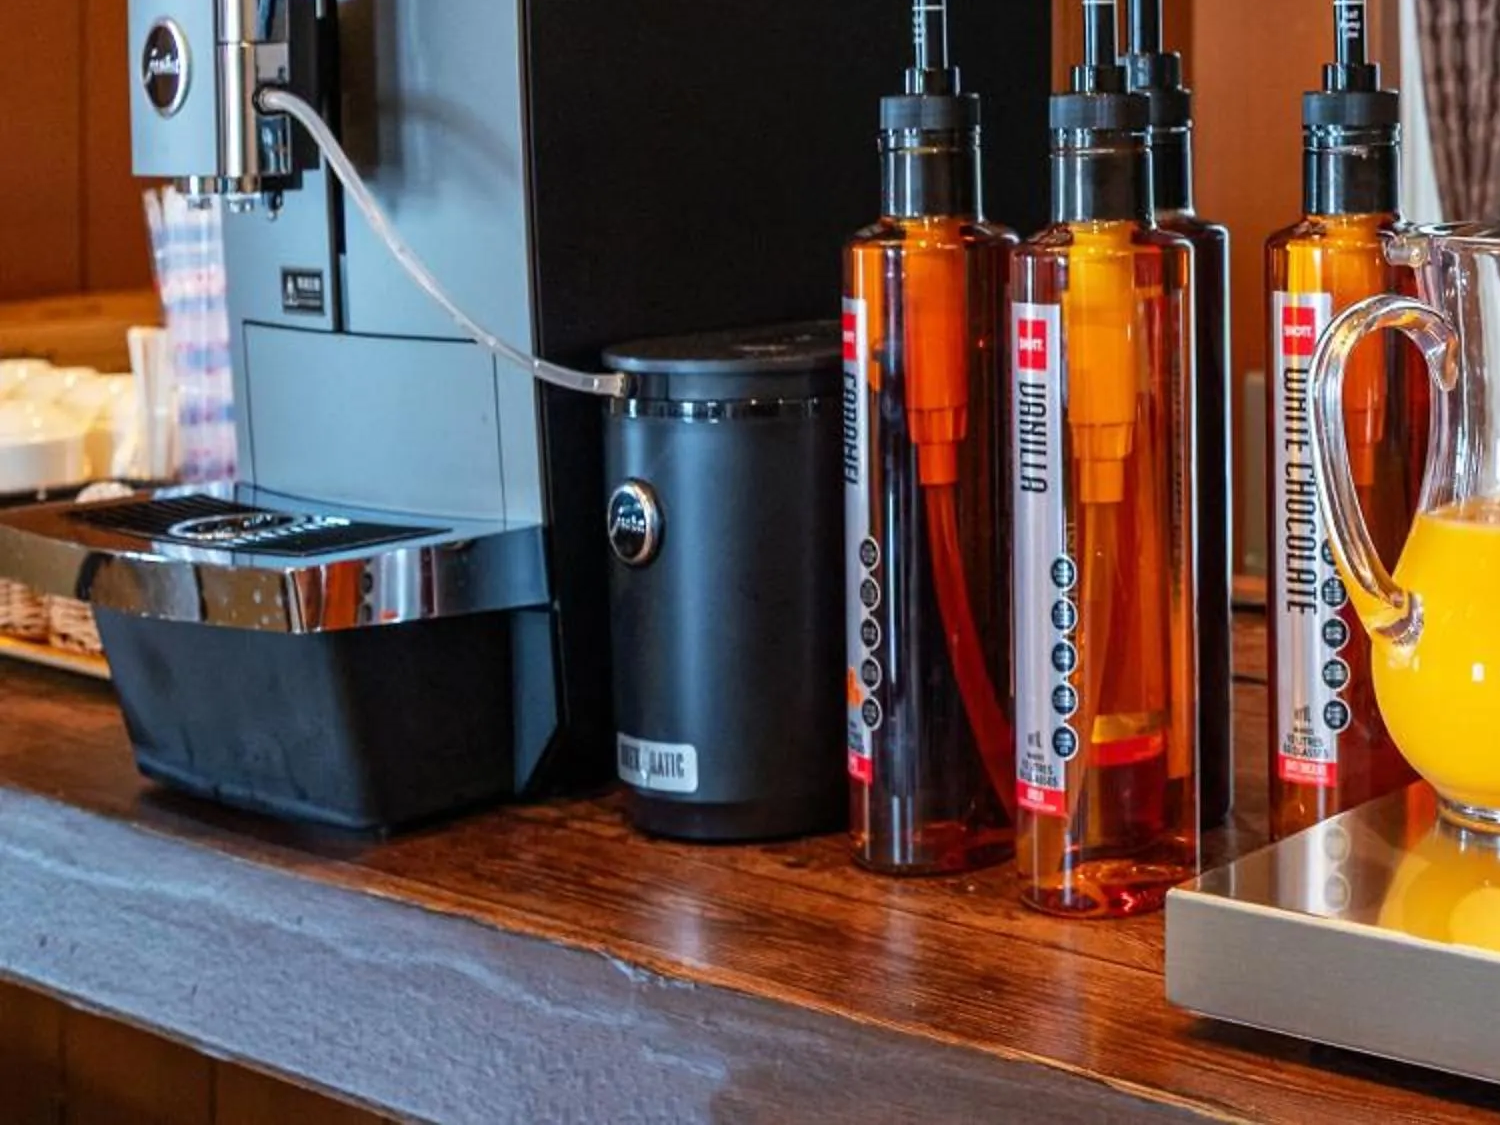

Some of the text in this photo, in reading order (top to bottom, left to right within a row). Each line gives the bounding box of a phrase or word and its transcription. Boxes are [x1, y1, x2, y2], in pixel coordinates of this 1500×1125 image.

[1019, 381, 1048, 493] VANILLA
[1283, 368, 1318, 615] WHITE CHOCOLATE
